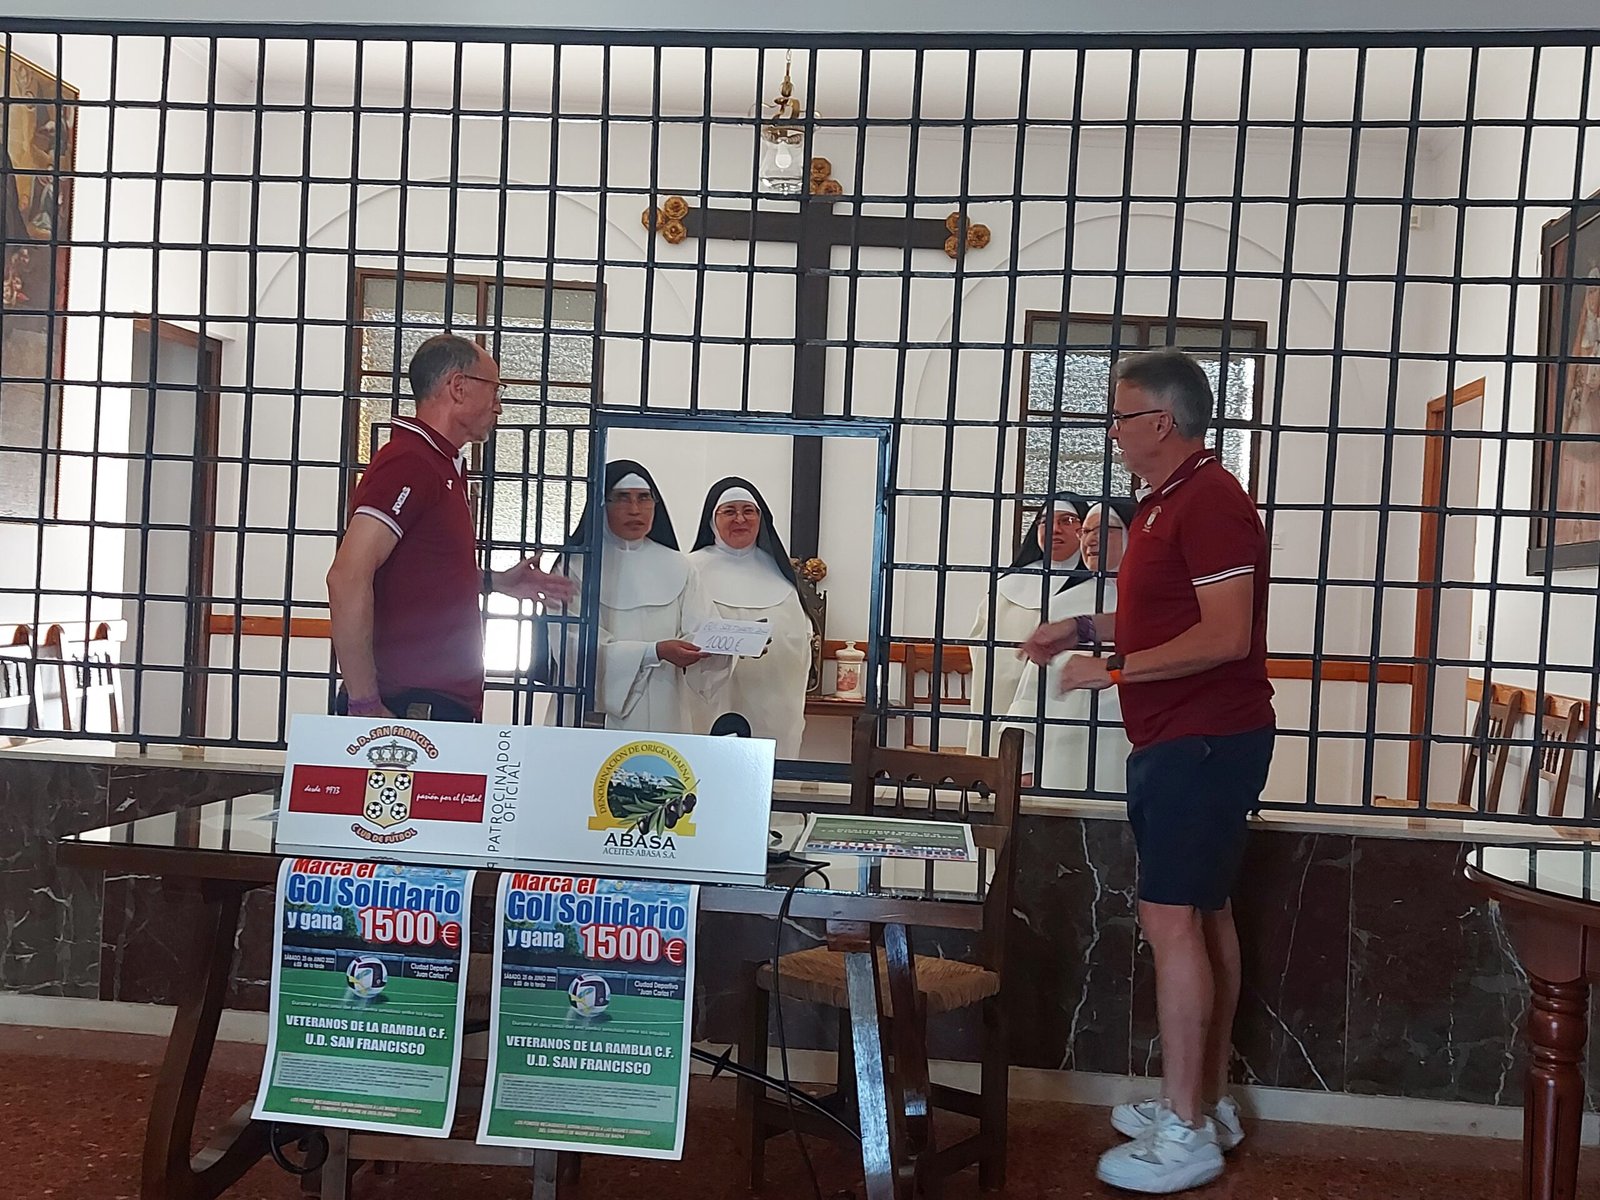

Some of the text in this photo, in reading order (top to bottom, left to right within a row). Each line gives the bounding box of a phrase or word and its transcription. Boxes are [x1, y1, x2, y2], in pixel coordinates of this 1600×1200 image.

[370, 726, 390, 740] SAN
[392, 726, 438, 759] FRANCISCO
[628, 744, 640, 755] DE
[640, 744, 673, 759] ORIGEN
[488, 730, 511, 852] PATROCINADOR
[503, 761, 520, 822] OFICIAL
[351, 822, 372, 841] CLUB
[371, 834, 384, 844] DE
[604, 832, 676, 851] ABASA
[602, 847, 634, 856] ACEITES
[634, 849, 661, 859] ABASA
[293, 859, 353, 876] Marca
[288, 873, 460, 914] Gol Solidario
[511, 873, 573, 892] Marca
[287, 911, 298, 929] y
[300, 912, 343, 930] gana
[508, 890, 685, 930] Gol Solidario
[507, 929, 518, 947] y
[521, 930, 564, 949] gana
[410, 962, 453, 972] Ciudad Deportiva
[634, 980, 678, 990] Ciudad Deportiva
[286, 1014, 447, 1039] VETERANOS DE LA RAMBLA C.F.
[305, 1033, 426, 1055] U.D. SAN FRANCISCO
[506, 1035, 674, 1059] VETERANOS DE LA RAMBLA C.F.
[526, 1053, 651, 1075] U.D. SAN FRANCISCO
